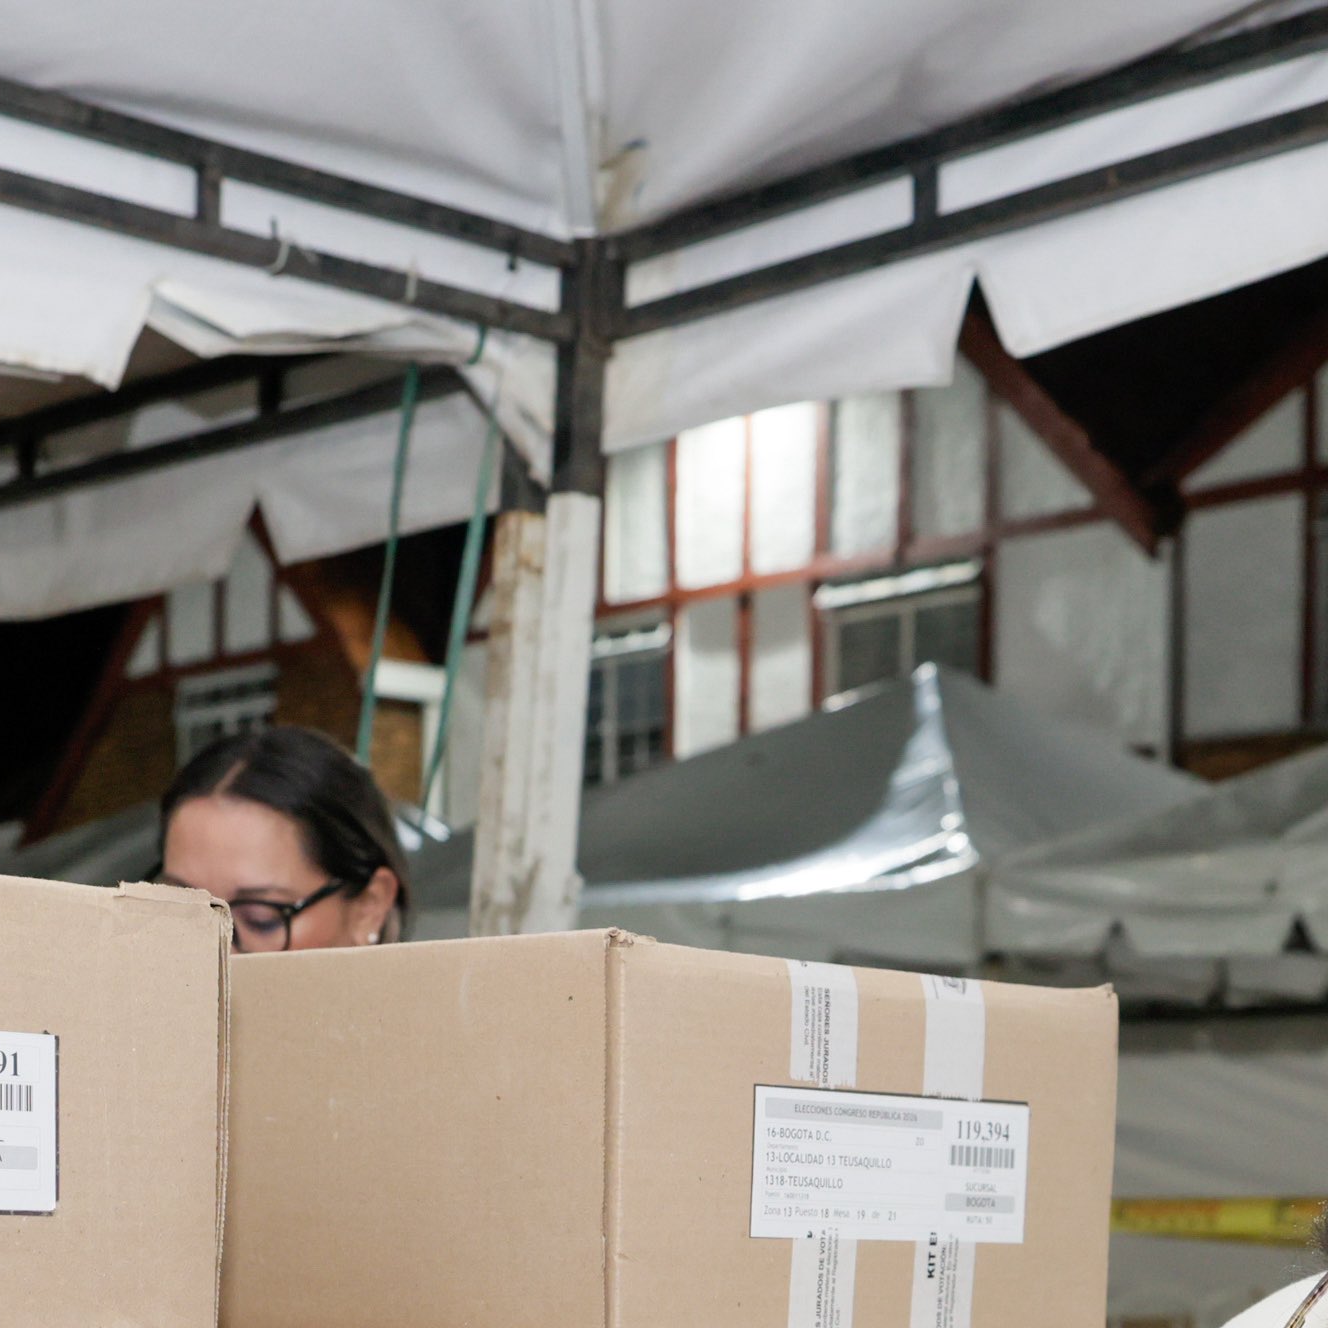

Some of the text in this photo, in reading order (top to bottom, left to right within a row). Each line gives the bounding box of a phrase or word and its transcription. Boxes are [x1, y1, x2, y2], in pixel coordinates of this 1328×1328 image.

[767, 1126, 832, 1142] 16-BOGOTA D.C.
[957, 1118, 1010, 1143] 119,394
[766, 1151, 891, 1170] 13-LOCALIDAD 13 TEUSAQUILLO
[764, 1174, 843, 1190] 1318-TEUSAQUILLO
[928, 1252, 936, 1279] KIT
